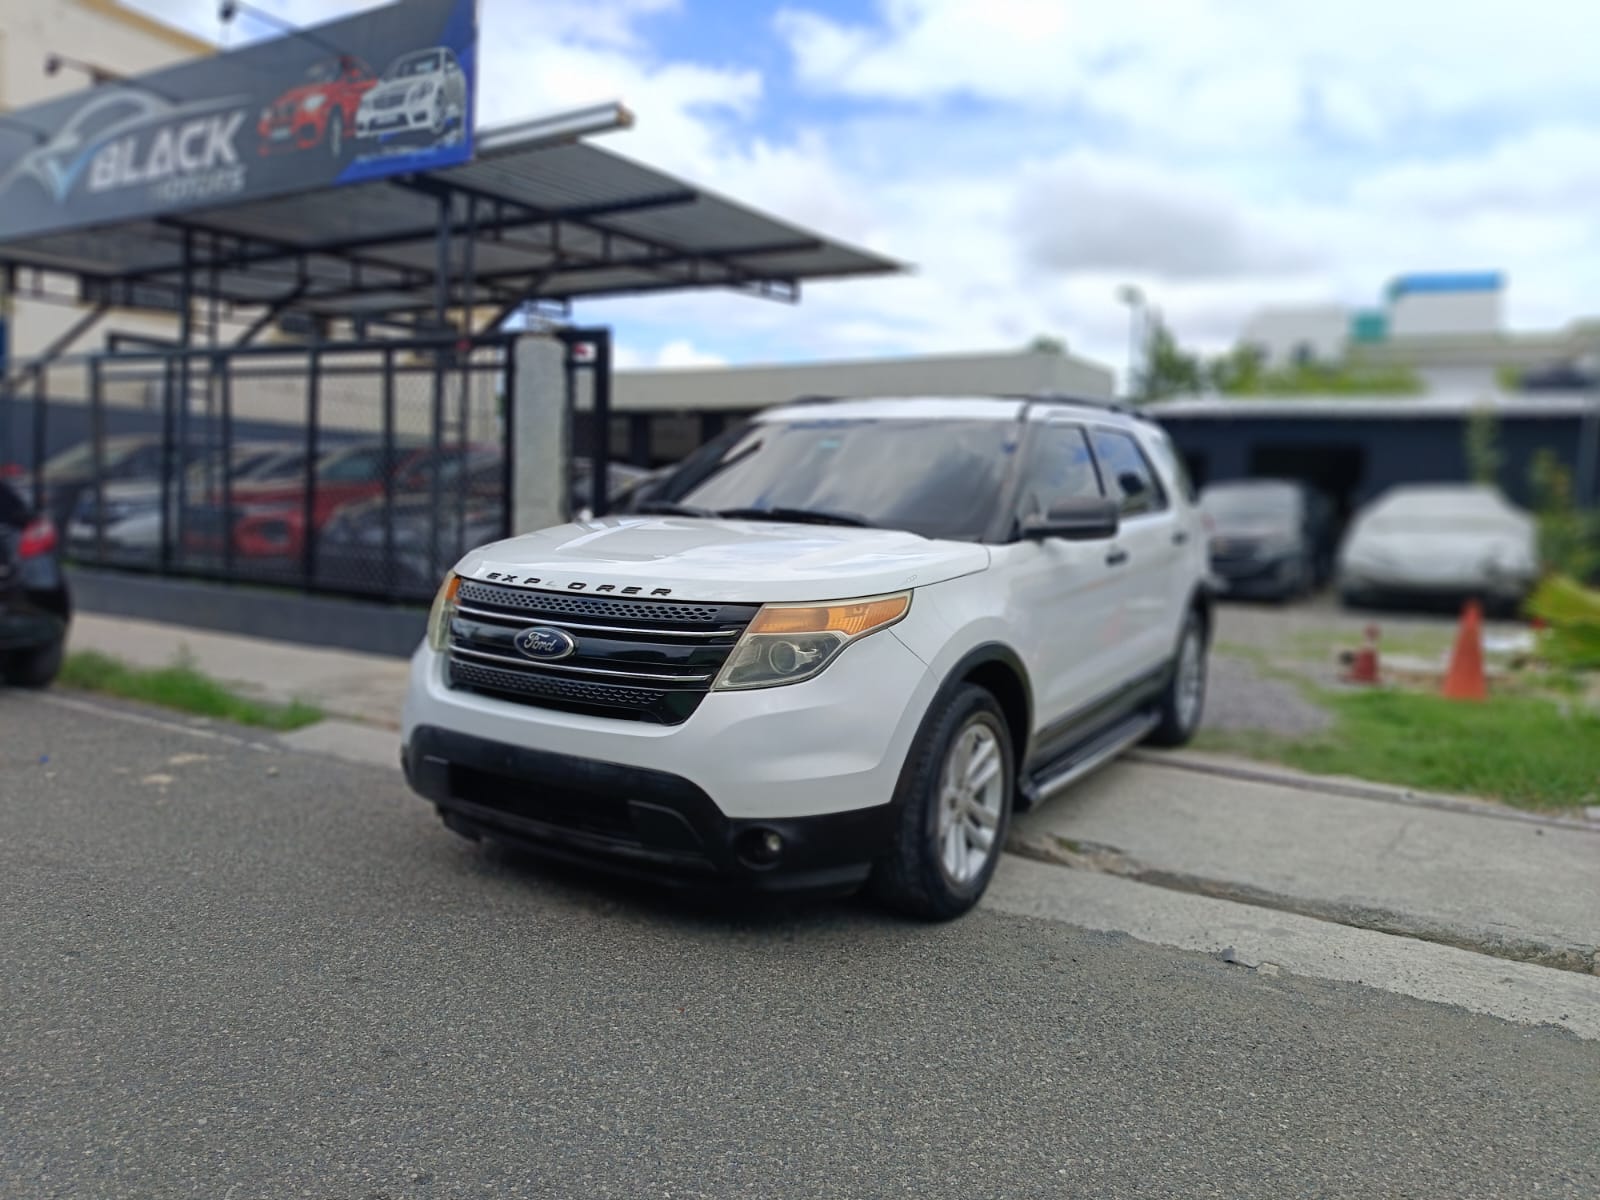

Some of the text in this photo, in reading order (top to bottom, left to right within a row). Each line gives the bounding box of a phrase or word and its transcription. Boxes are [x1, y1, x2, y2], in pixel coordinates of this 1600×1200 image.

[89, 112, 246, 192] BLACK
[486, 572, 673, 597] EXPLORER
[523, 631, 558, 652] Ford
